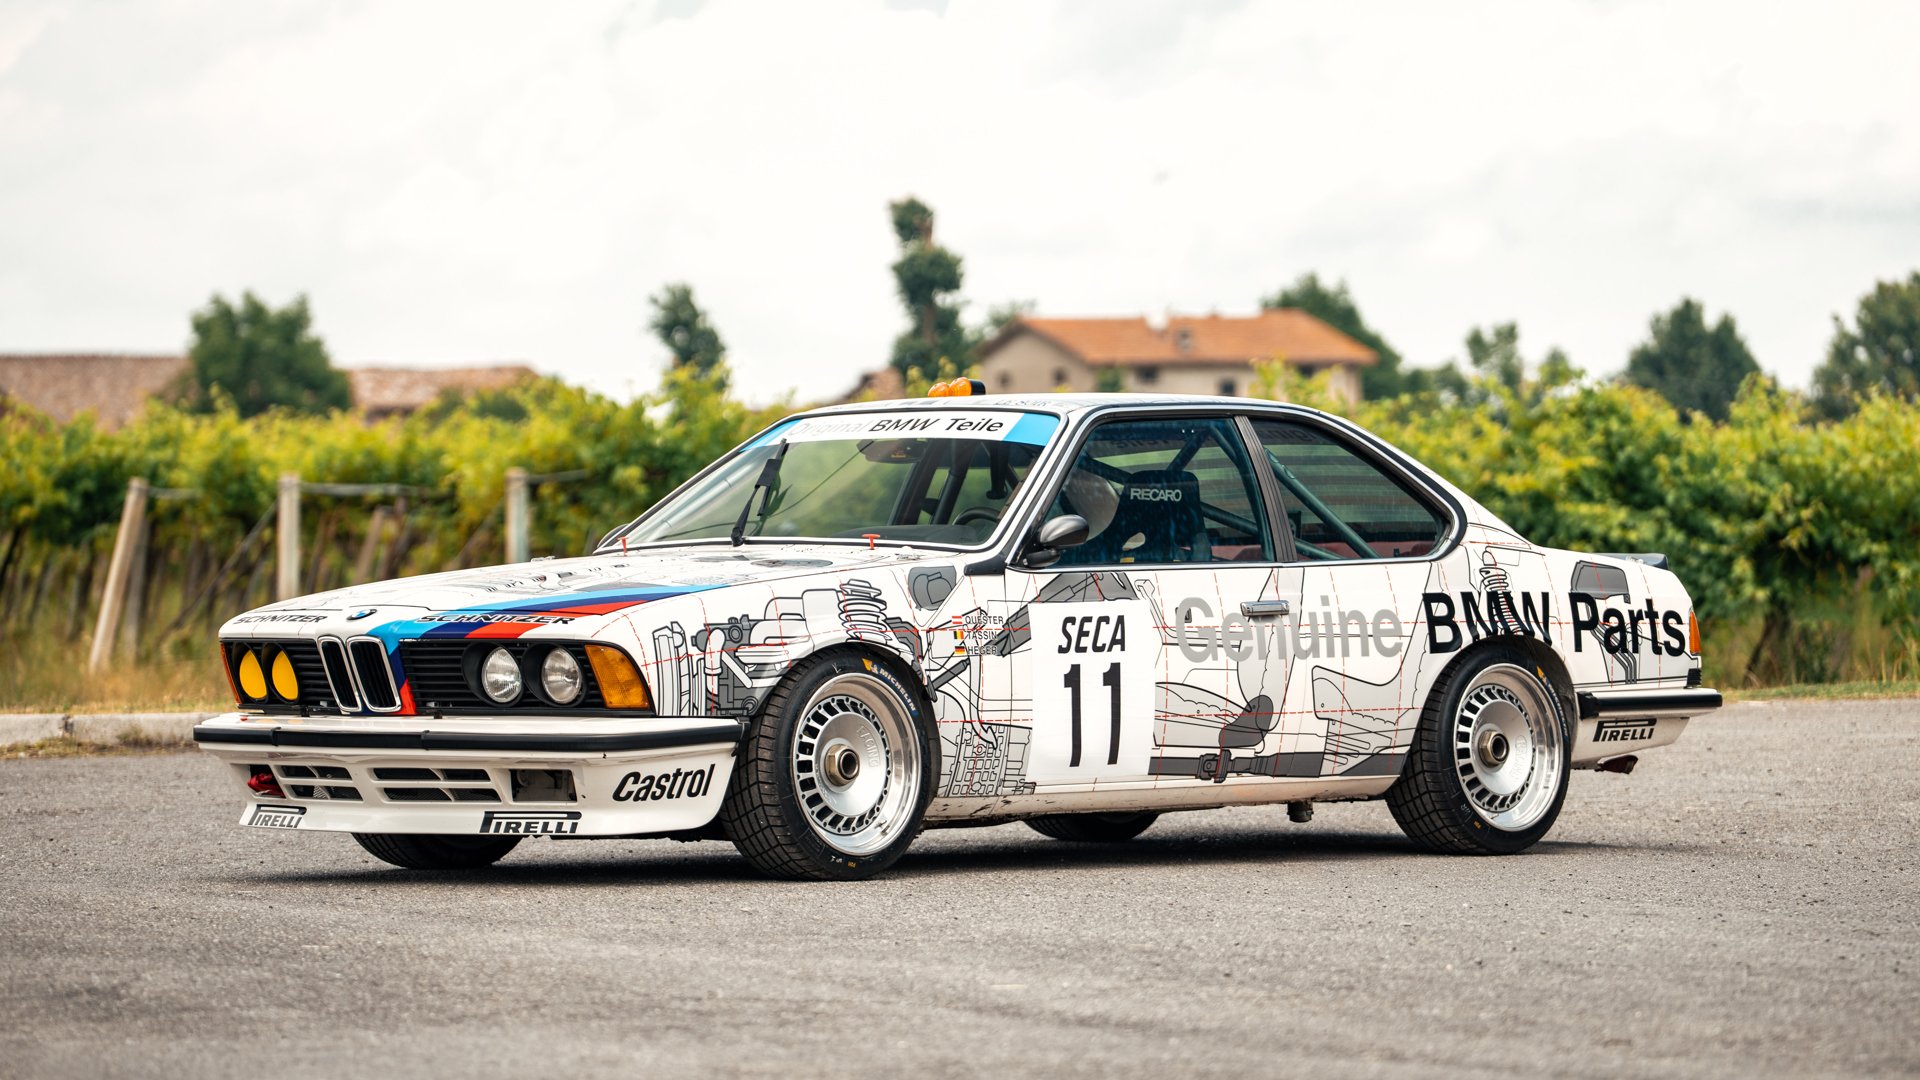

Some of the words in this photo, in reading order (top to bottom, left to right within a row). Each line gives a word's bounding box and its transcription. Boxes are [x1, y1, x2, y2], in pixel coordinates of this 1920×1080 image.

[868, 418, 940, 432] BMW
[944, 418, 1005, 432] Teile
[1130, 488, 1182, 501] RECARO
[233, 615, 328, 625] SCHNITZER
[415, 614, 577, 626] SCHNITZER
[965, 616, 1004, 625] QUESTER
[1175, 595, 1403, 663] Genuine
[1422, 591, 1553, 654] BMW
[1568, 592, 1686, 657] Parts
[967, 631, 997, 640] TASSIN
[1058, 614, 1126, 654] SECA
[967, 646, 997, 655] HEGER
[879, 668, 916, 711] MICHELIN
[1063, 662, 1121, 767] 11
[1593, 718, 1657, 742] PIRELLI
[612, 763, 716, 802] Castrol
[248, 804, 307, 829] PIRELLI
[479, 810, 582, 834] PIRELLI
